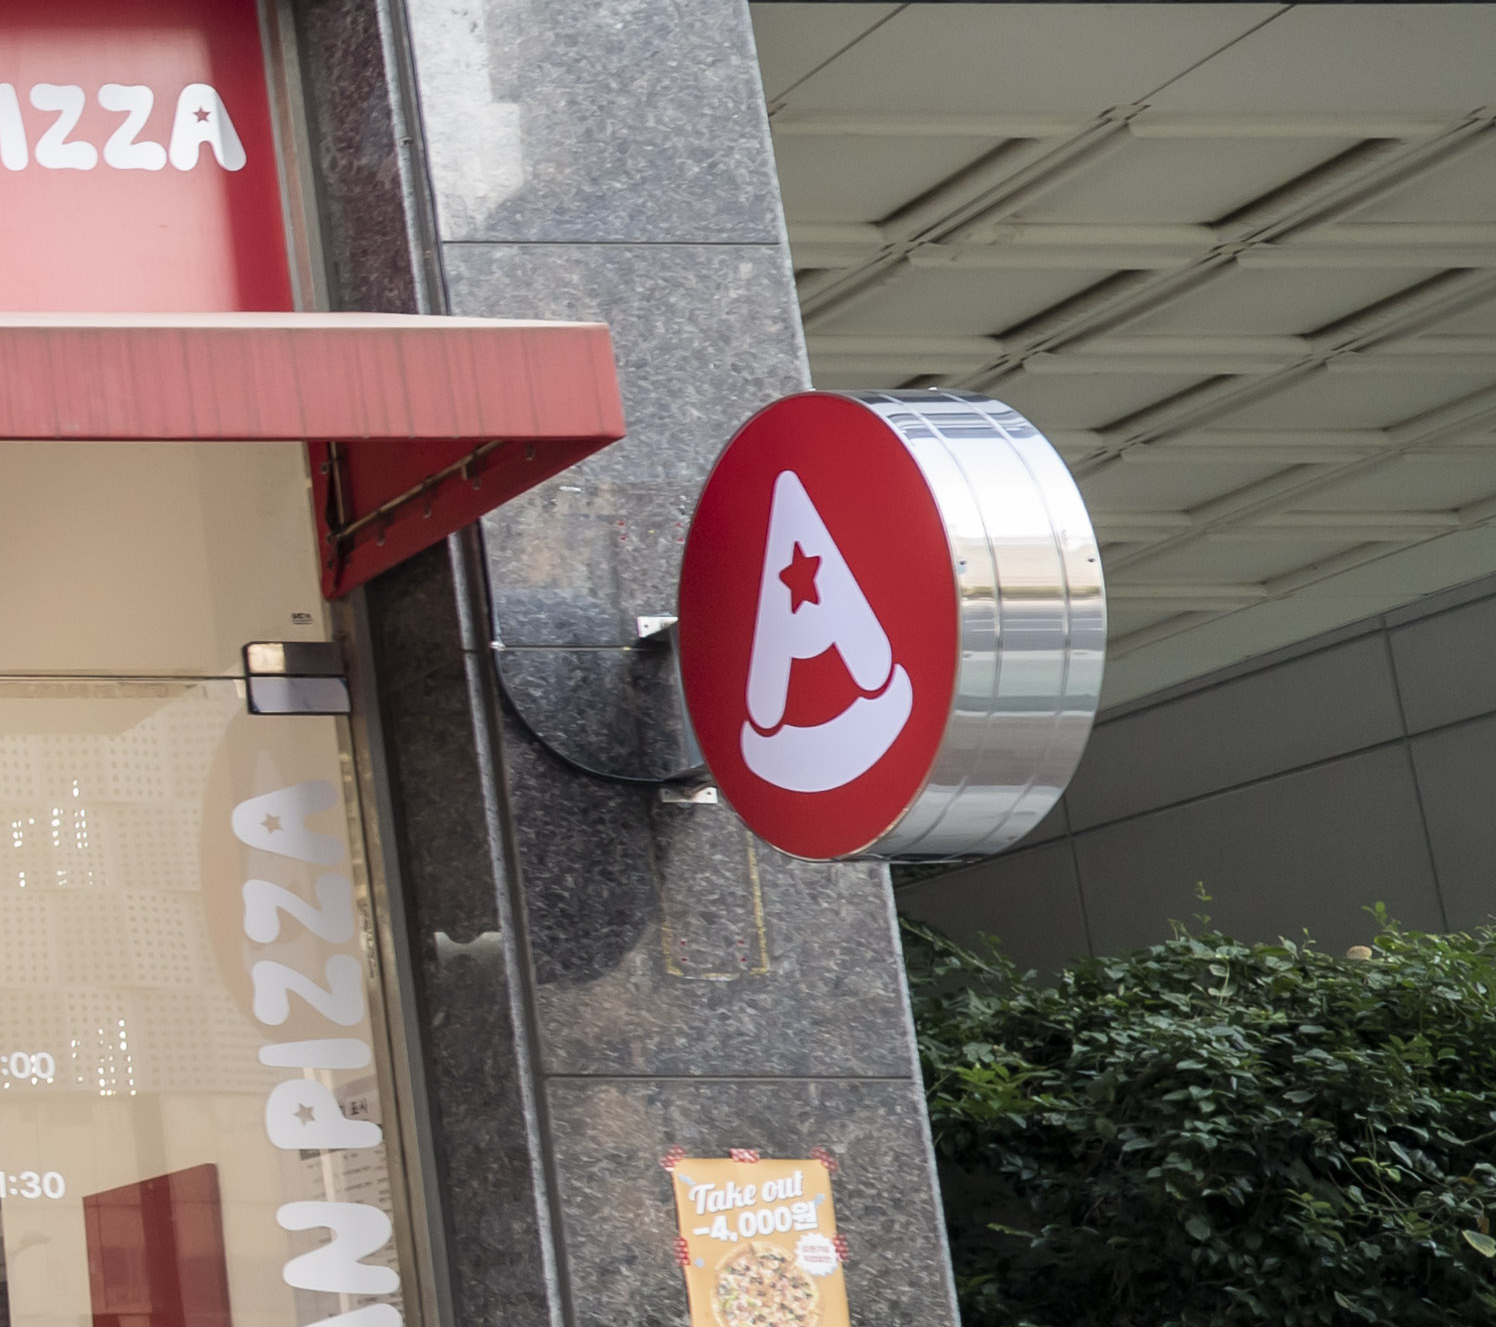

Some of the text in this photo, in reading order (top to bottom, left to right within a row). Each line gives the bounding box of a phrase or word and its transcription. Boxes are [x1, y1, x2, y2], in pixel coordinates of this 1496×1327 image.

[230, 778, 384, 1151] PIZZA
[688, 1170, 804, 1215] Take out
